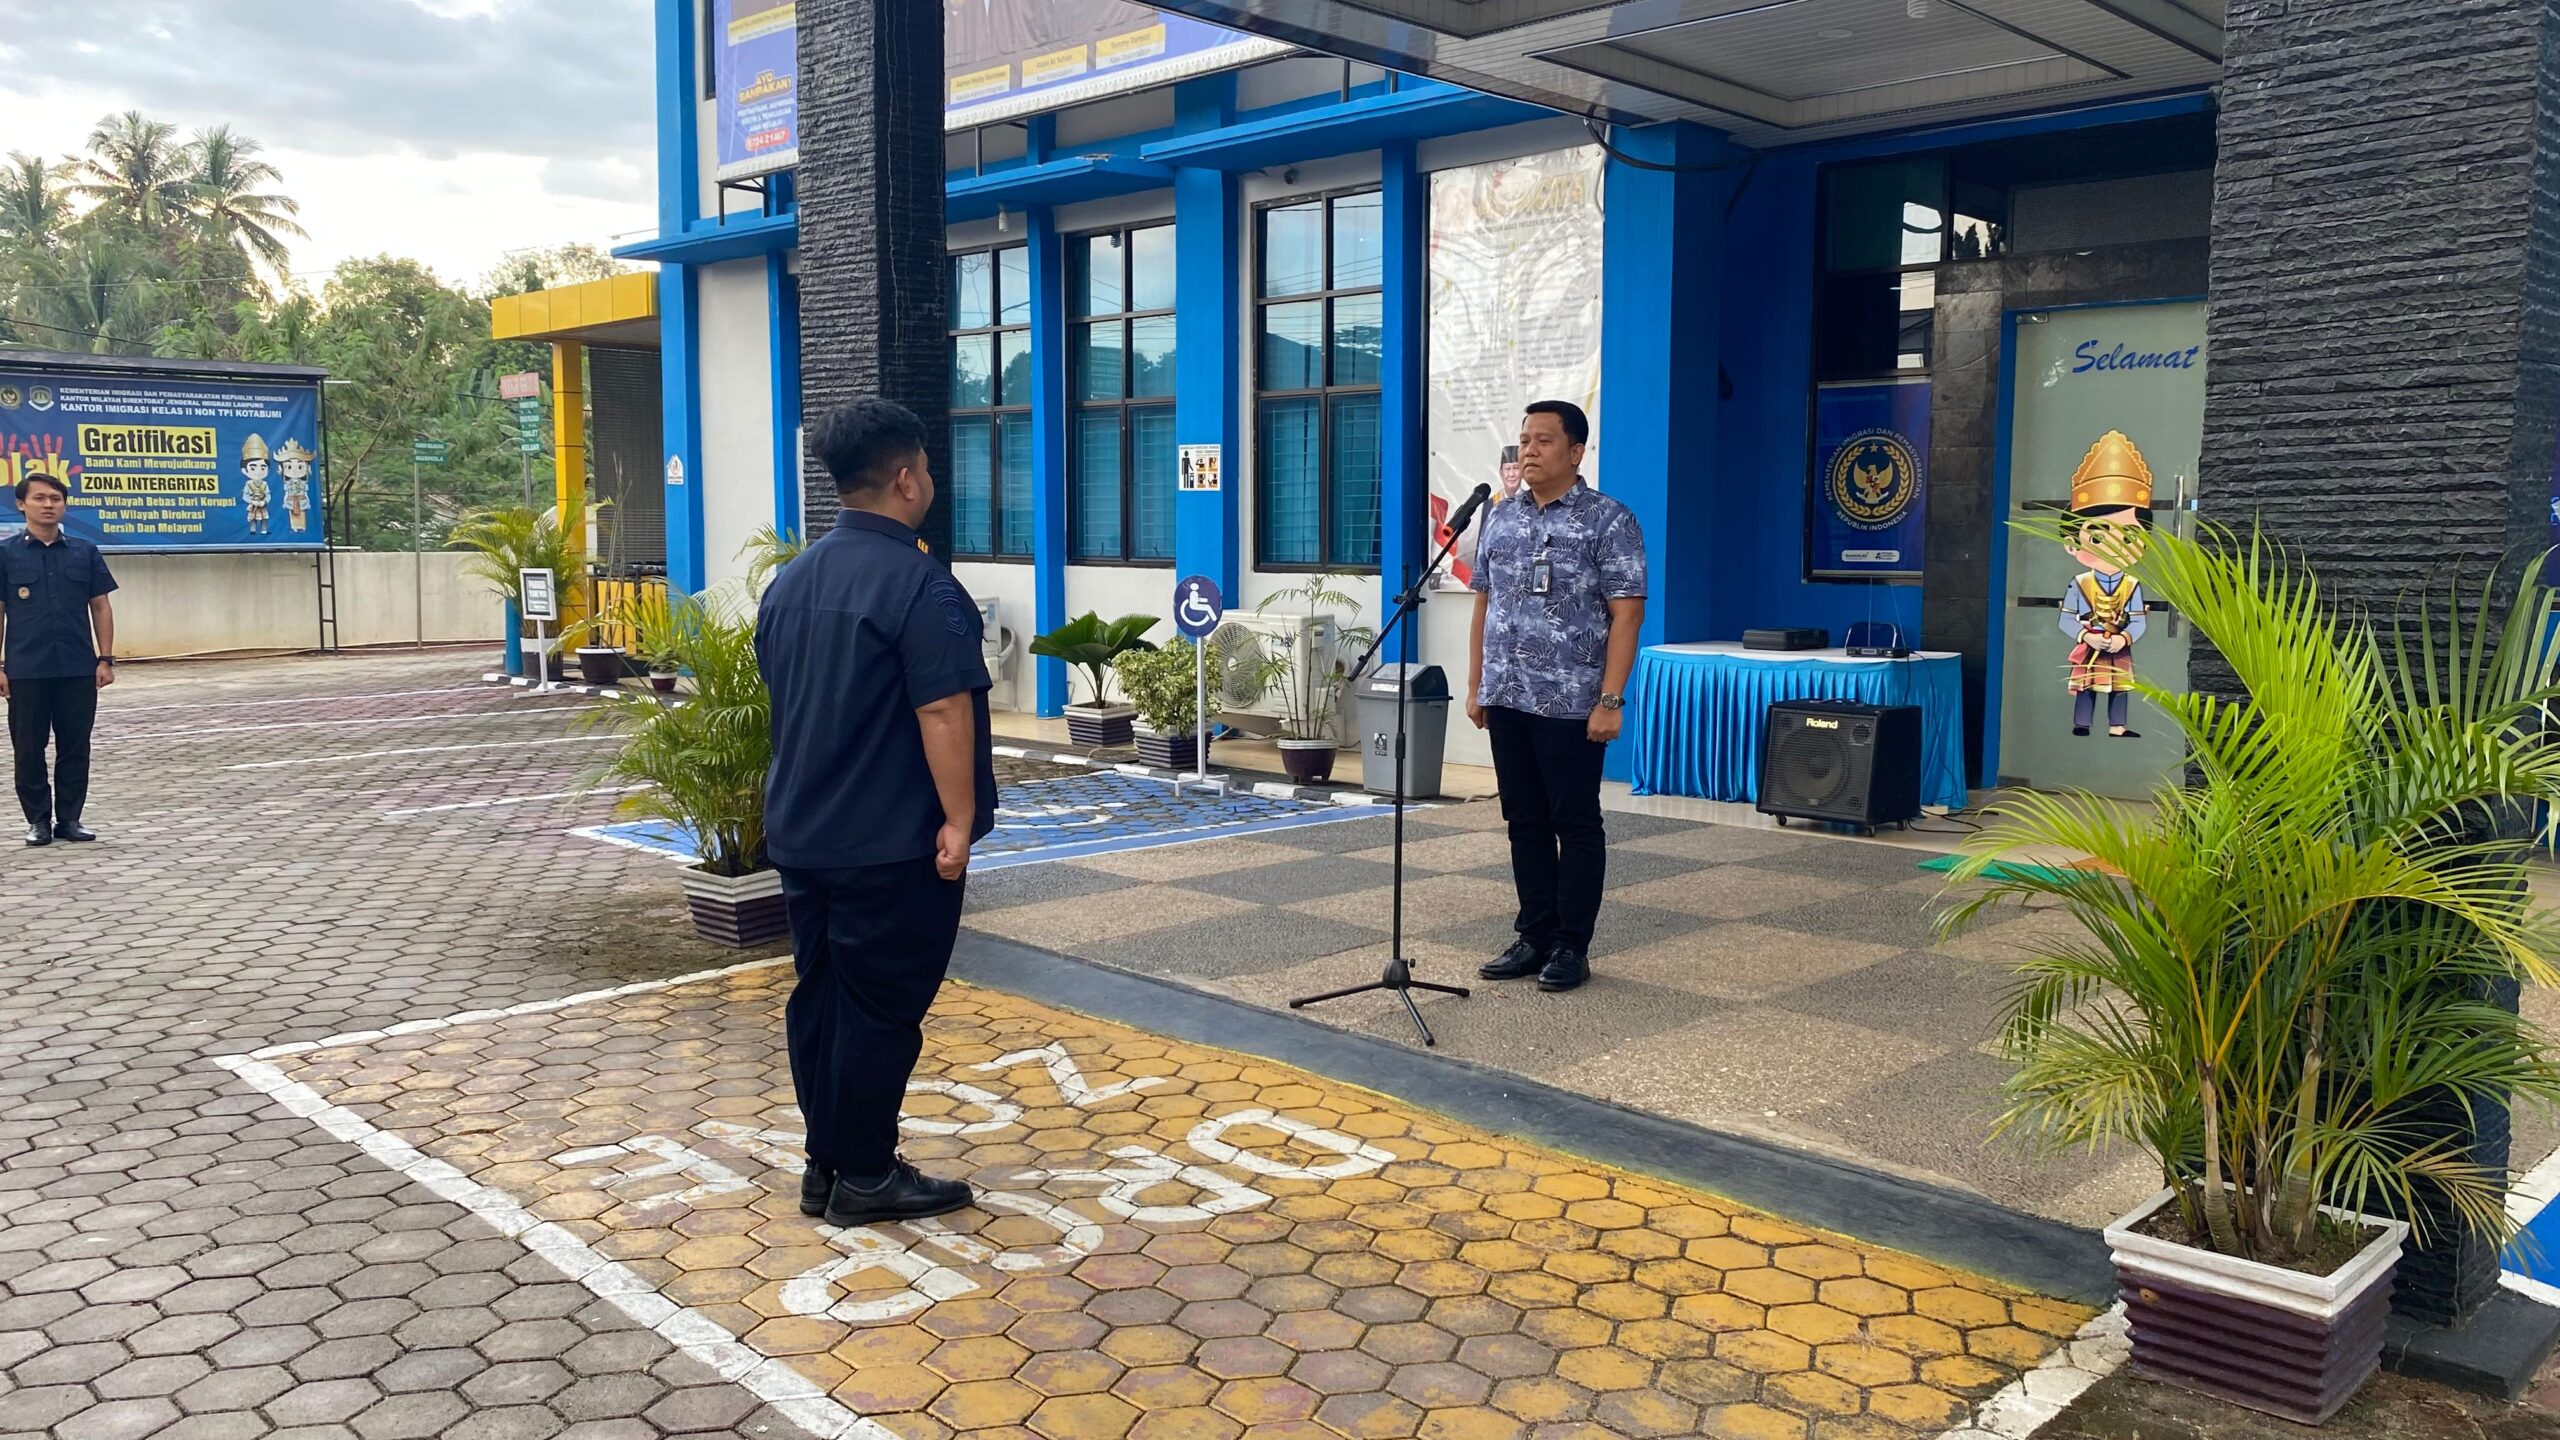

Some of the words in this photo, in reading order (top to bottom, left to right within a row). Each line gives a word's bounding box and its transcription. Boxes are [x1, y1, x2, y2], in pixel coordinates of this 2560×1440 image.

[2072, 340, 2200, 374] Selamat
[60, 387, 110, 395] KEMENTERIAN
[111, 389, 142, 397] IMIGRASI
[123, 397, 164, 405] DIREKTORAT
[233, 401, 264, 409] LAMPUNG
[61, 402, 103, 412] KANTOR
[105, 404, 149, 414] IMIGRASI
[152, 406, 183, 415] KELAS
[185, 407, 192, 416] II
[195, 408, 215, 416] NON
[217, 408, 233, 417] TPI
[236, 409, 282, 418] KOTABUMI
[84, 427, 212, 454] Gratifikasi
[85, 457, 114, 468] Bantu
[116, 457, 142, 468] Kami
[144, 458, 217, 470] Mewujudkanya
[1824, 446, 1843, 501] KEMENTERIAN
[1841, 428, 1875, 448] IMIGRASI
[1876, 427, 1894, 437] DAN
[1893, 432, 1923, 500] PEMASYARAKATAN
[84, 476, 123, 490] ZONA
[127, 477, 216, 491] INTERGRITAS
[67, 496, 102, 507] Menuju
[104, 496, 144, 508] Wilayah
[146, 496, 176, 507] Bebas
[178, 496, 199, 507] Dari
[200, 496, 237, 508] Korupsi
[98, 509, 118, 520] Dan
[120, 509, 160, 521] Wilayah
[162, 509, 206, 520] Birokrasi
[1835, 510, 1868, 531] REPUBLIK
[1869, 510, 1908, 531] INDONESIA
[103, 522, 135, 533] Bersih
[137, 523, 156, 533] Dan
[158, 523, 203, 534] Melayani
[1806, 717, 1839, 730] Roland
